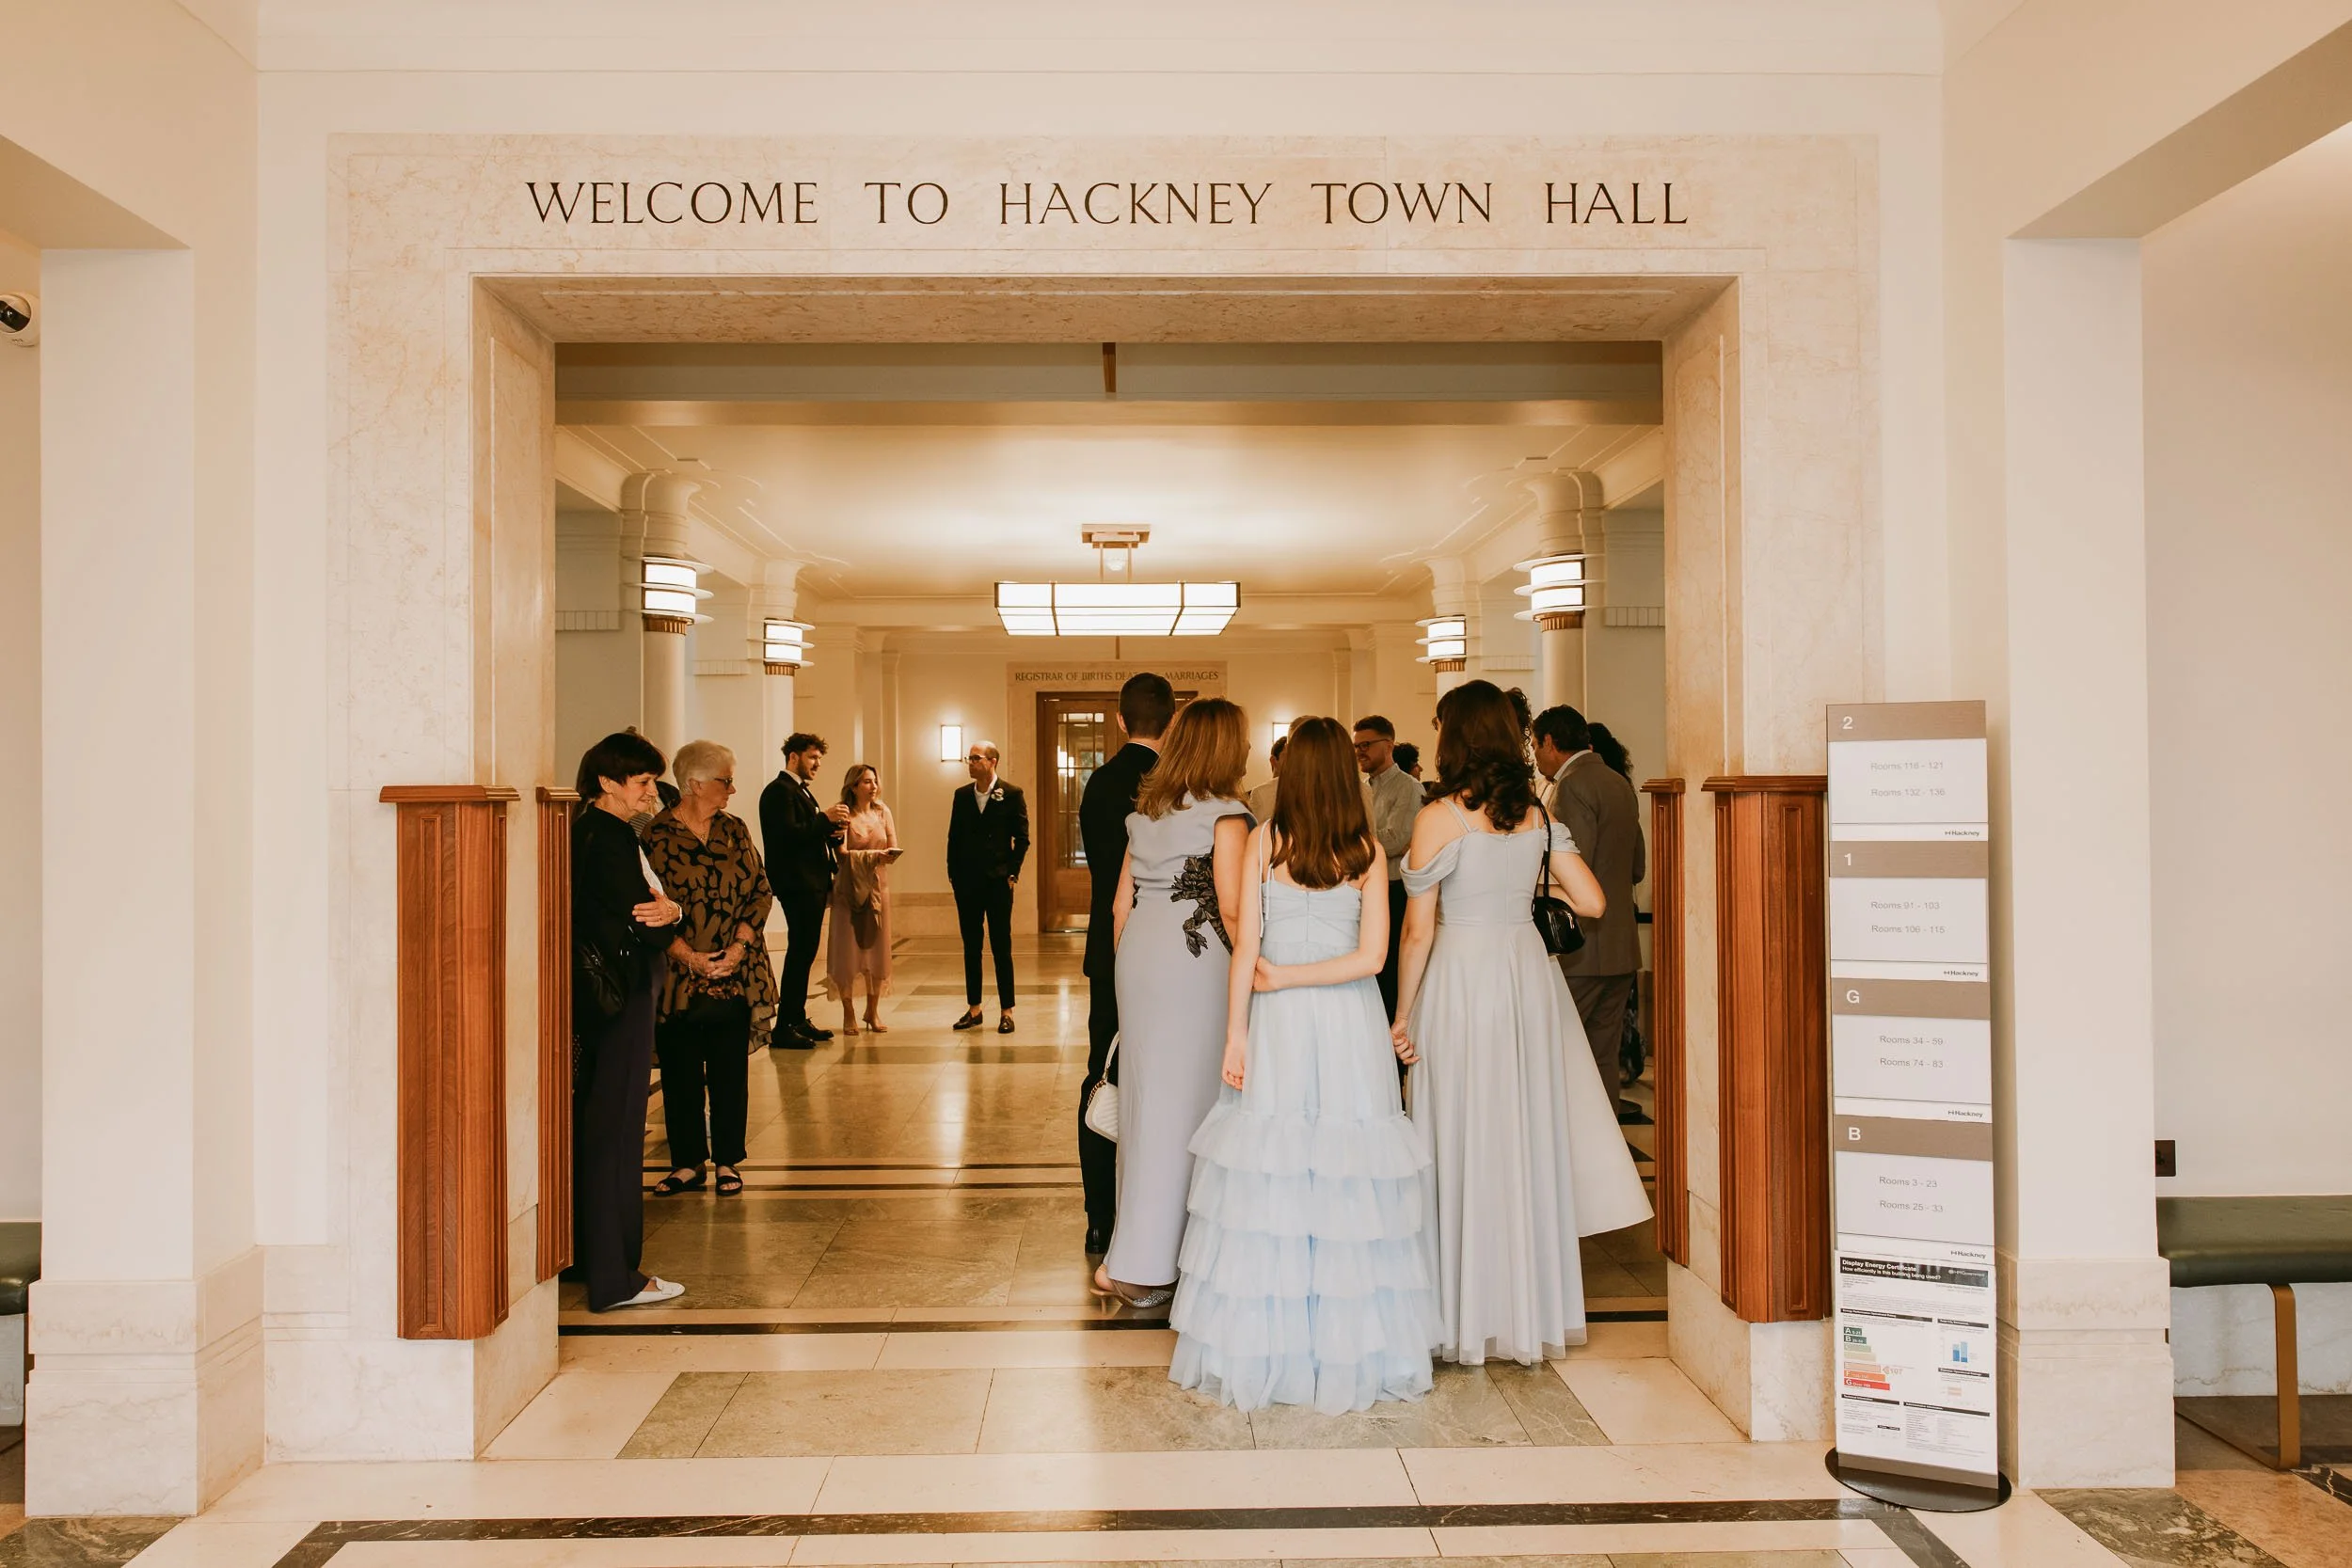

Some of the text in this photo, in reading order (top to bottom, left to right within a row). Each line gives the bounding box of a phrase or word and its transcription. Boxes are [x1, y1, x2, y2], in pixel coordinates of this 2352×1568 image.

[526, 182, 1687, 224] WELCOME TO HACKNEY TOWN HALL
[1015, 672, 1063, 681] REGISTRAR
[1065, 672, 1079, 681] OF
[1082, 672, 1112, 681] BIRTHS
[1843, 716, 1853, 729] 2
[1871, 762, 1902, 770] Rooms
[1929, 761, 1943, 770] 121
[1871, 789, 1901, 797] Rooms
[1844, 853, 1852, 866] 1
[1930, 926, 1945, 934] 115
[1846, 990, 1860, 1003] G
[1880, 1035, 1910, 1044] Rooms
[1880, 1058, 1910, 1066] Rooms
[1848, 1127, 1861, 1140] B
[1879, 1176, 1910, 1186] Rooms
[1880, 1200, 1910, 1210] Rooms
[1842, 1259, 1917, 1272] Display Energy Certificate
